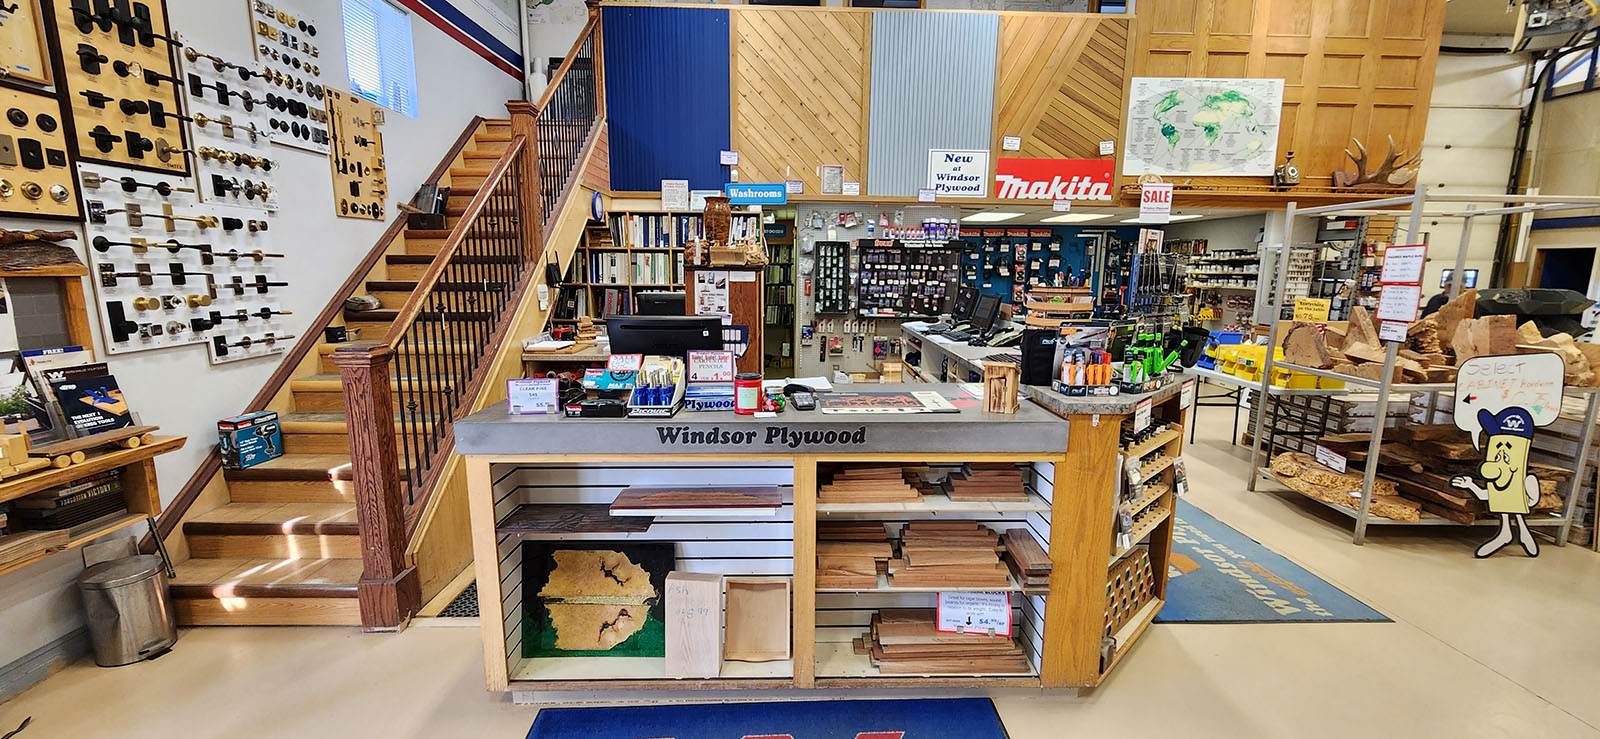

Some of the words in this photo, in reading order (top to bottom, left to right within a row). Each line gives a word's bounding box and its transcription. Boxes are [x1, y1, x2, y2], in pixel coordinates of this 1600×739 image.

[944, 153, 974, 163] New
[936, 173, 981, 182] Windsor
[729, 188, 783, 198] Washrooms
[935, 183, 981, 193] Plywood
[1143, 190, 1170, 203] SALE
[691, 372, 698, 380] 4
[1506, 420, 1521, 428] W
[656, 426, 757, 445] Windsor
[764, 426, 866, 448] Plywood
[87, 483, 112, 498] VICTORY
[1191, 546, 1302, 616] Windsor
